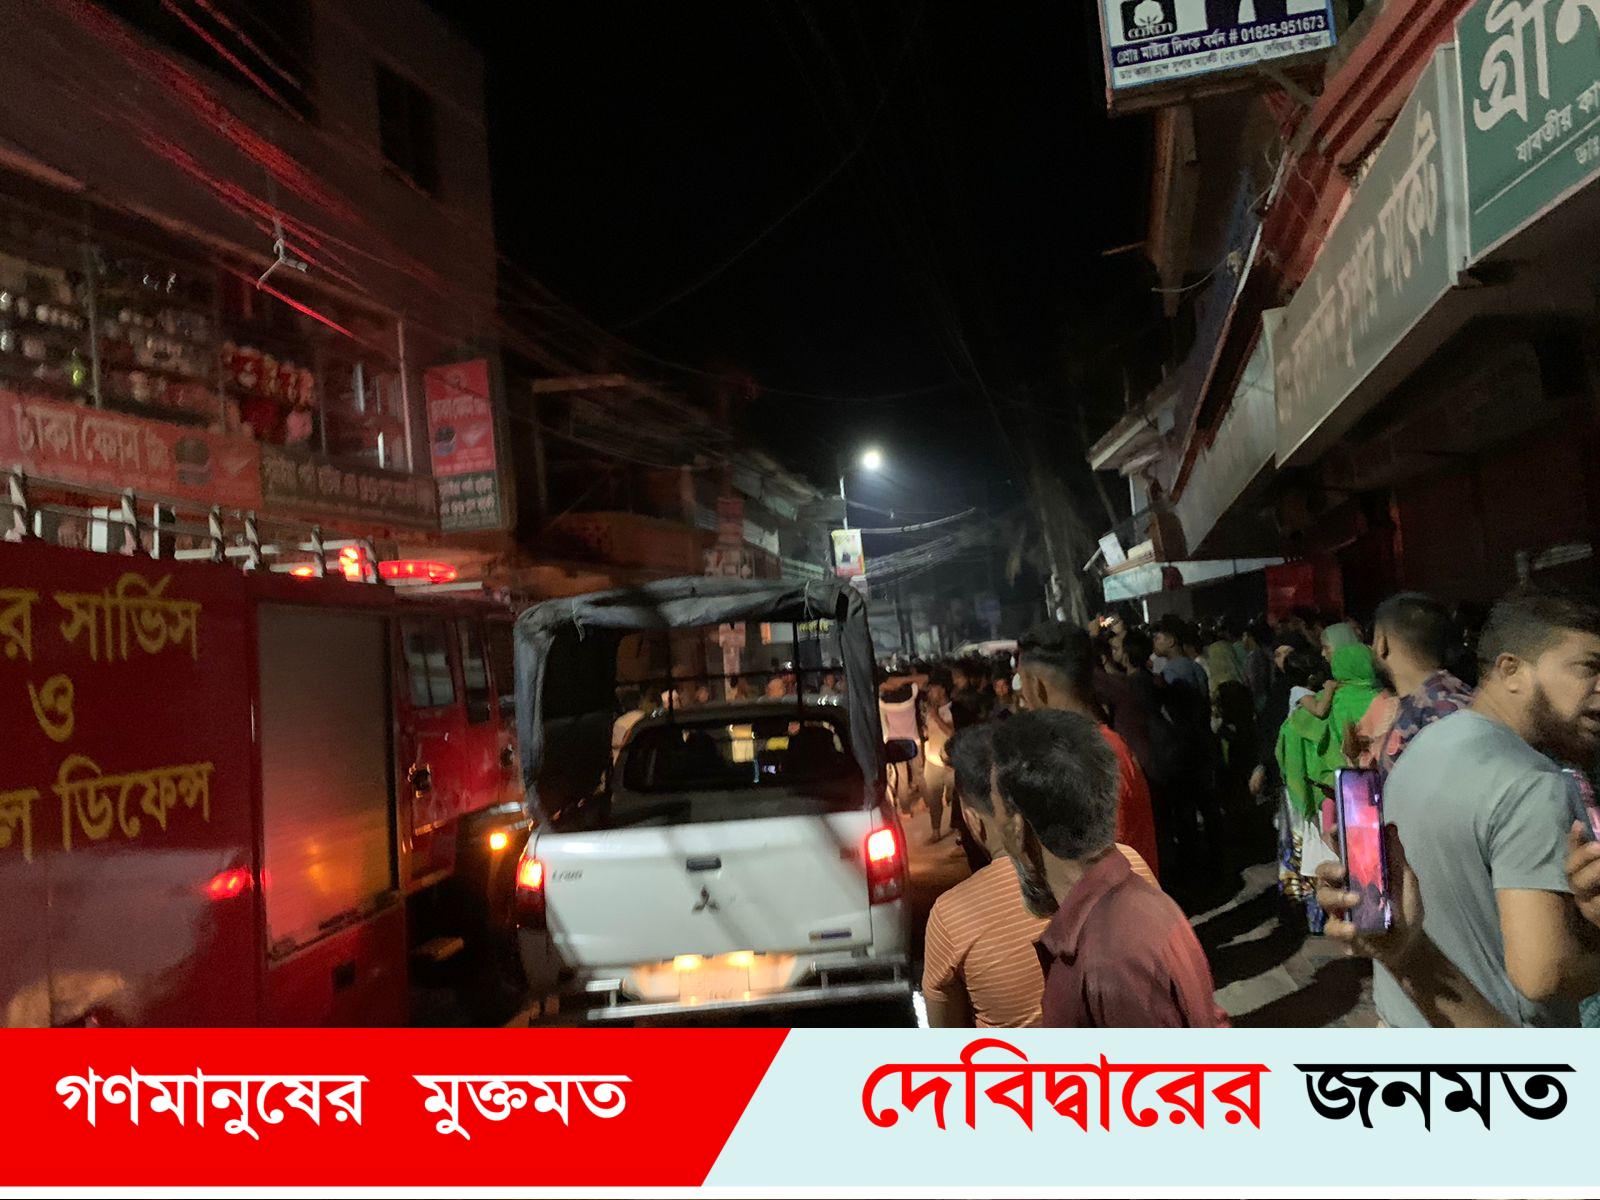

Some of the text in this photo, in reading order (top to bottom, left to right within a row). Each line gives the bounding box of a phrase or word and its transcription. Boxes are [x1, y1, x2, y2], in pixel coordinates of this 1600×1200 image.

[54, 572, 202, 662] সার্ভিস
[28, 673, 74, 742] ও
[52, 753, 215, 850] ডিফেন্স
